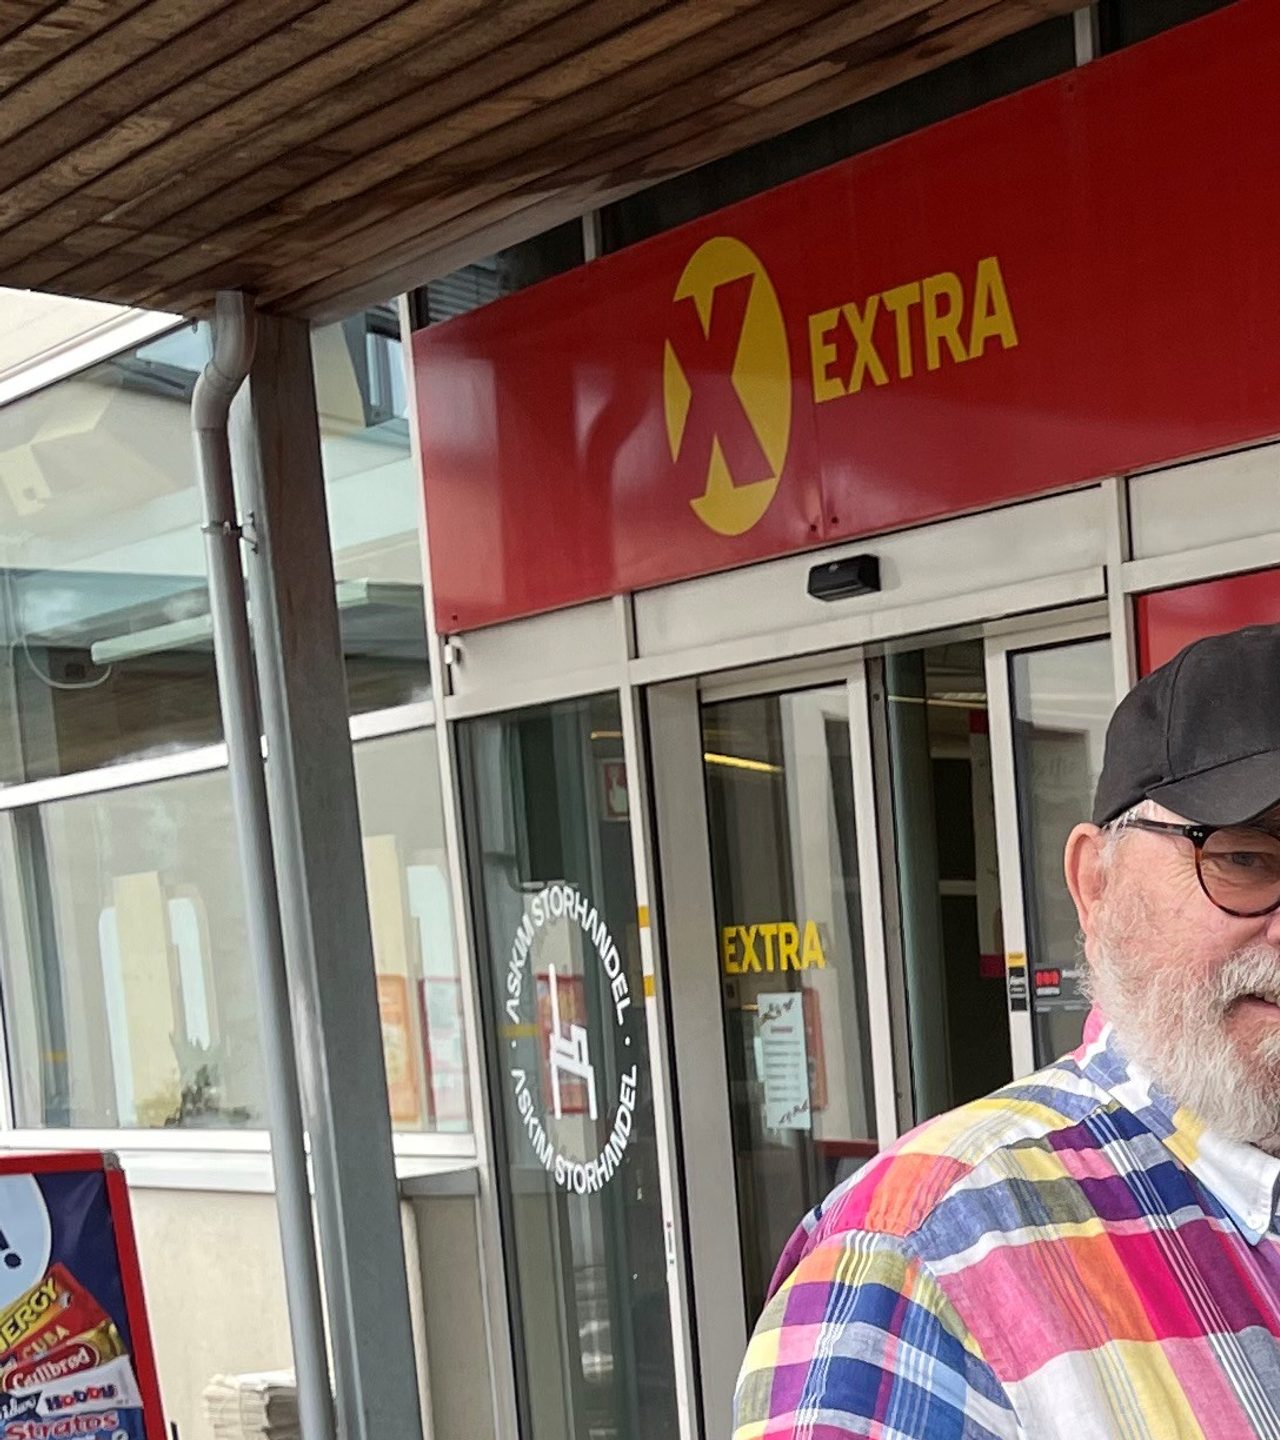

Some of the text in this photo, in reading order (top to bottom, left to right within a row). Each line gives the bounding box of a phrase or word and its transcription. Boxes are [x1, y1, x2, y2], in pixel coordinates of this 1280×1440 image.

[808, 256, 1018, 403] EXTRA
[506, 885, 632, 1025] ASKIM STORHANDEL
[722, 920, 825, 973] EXTRA
[511, 1069, 554, 1170] ASKIM
[554, 1064, 638, 1195] STORHANDEL
